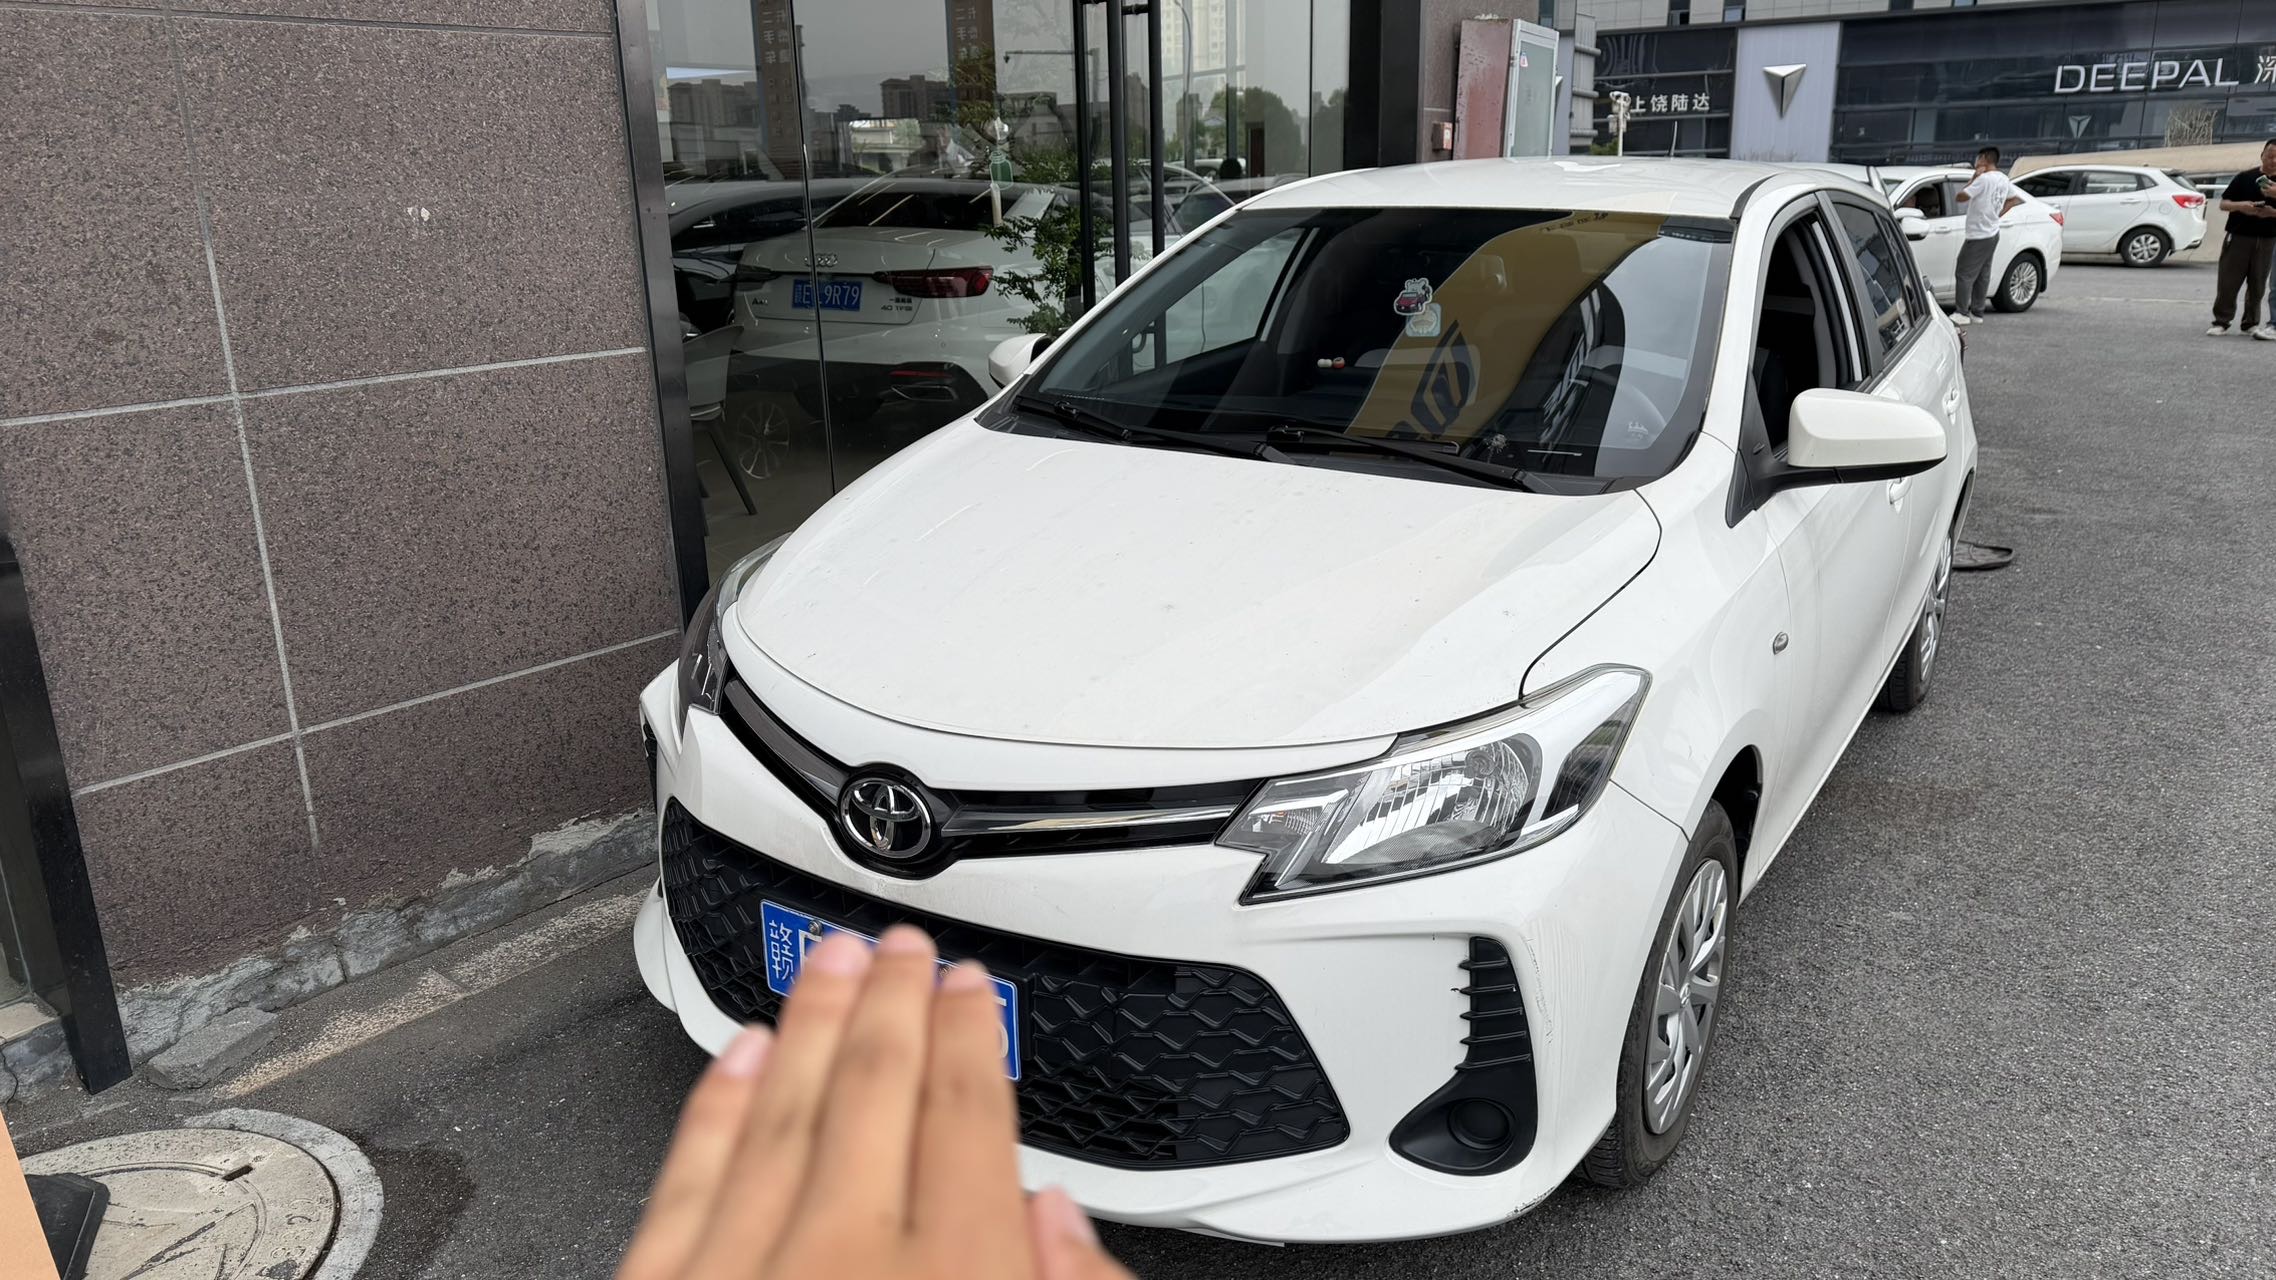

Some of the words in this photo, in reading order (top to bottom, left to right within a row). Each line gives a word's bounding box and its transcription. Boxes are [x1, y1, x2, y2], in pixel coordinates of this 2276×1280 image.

[2054, 57, 2239, 93] DEEPAL
[1630, 92, 1710, 113] 上饶陆达
